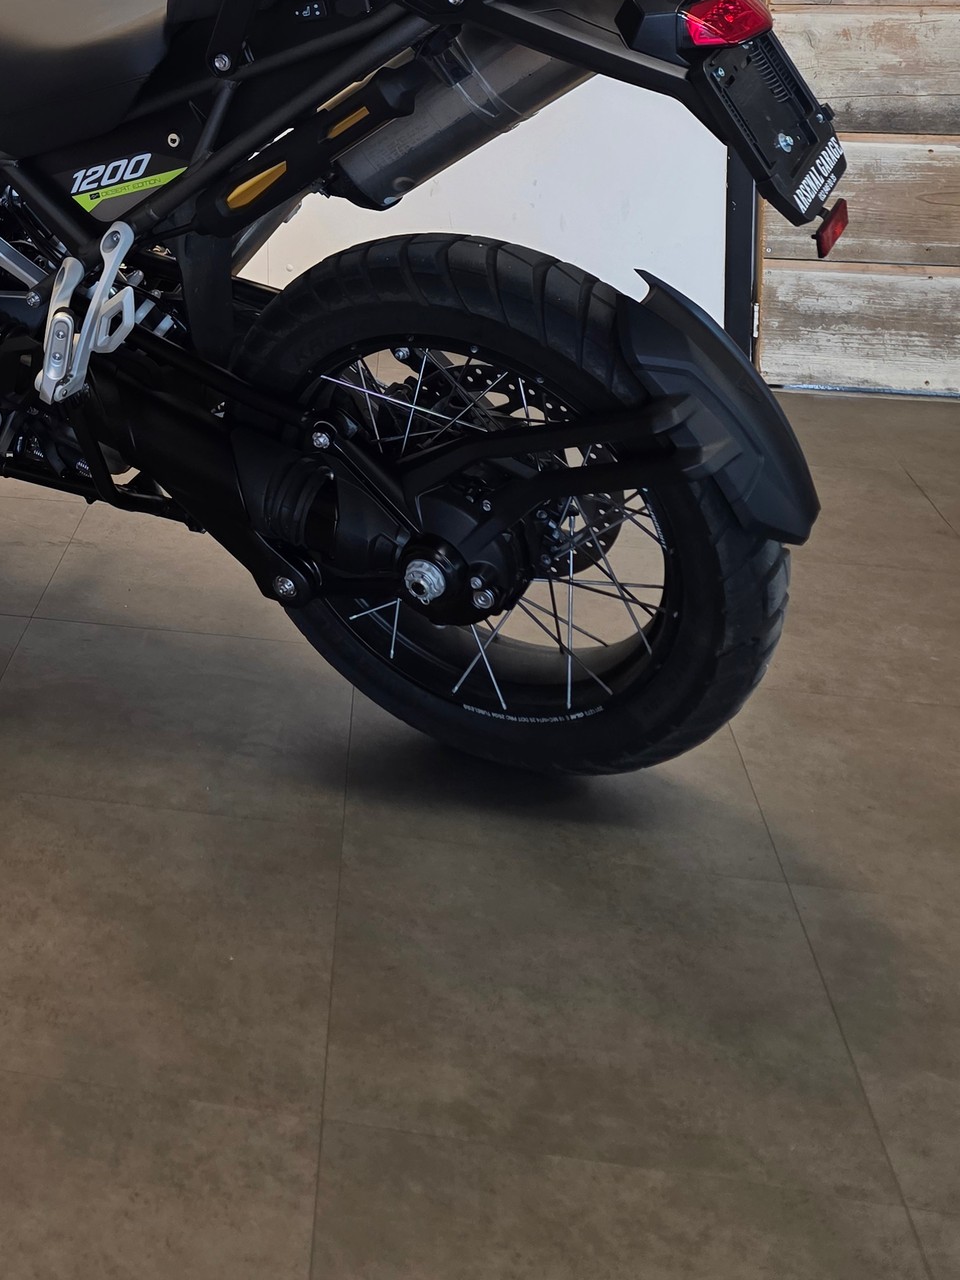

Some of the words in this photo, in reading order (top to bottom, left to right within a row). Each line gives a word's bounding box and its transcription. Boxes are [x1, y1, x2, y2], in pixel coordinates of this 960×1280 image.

[70, 153, 152, 194] 1200
[101, 185, 130, 197] DESERT
[132, 177, 162, 190] EDITION
[793, 166, 825, 214] ARSENAL
[815, 136, 844, 177] GARAGE
